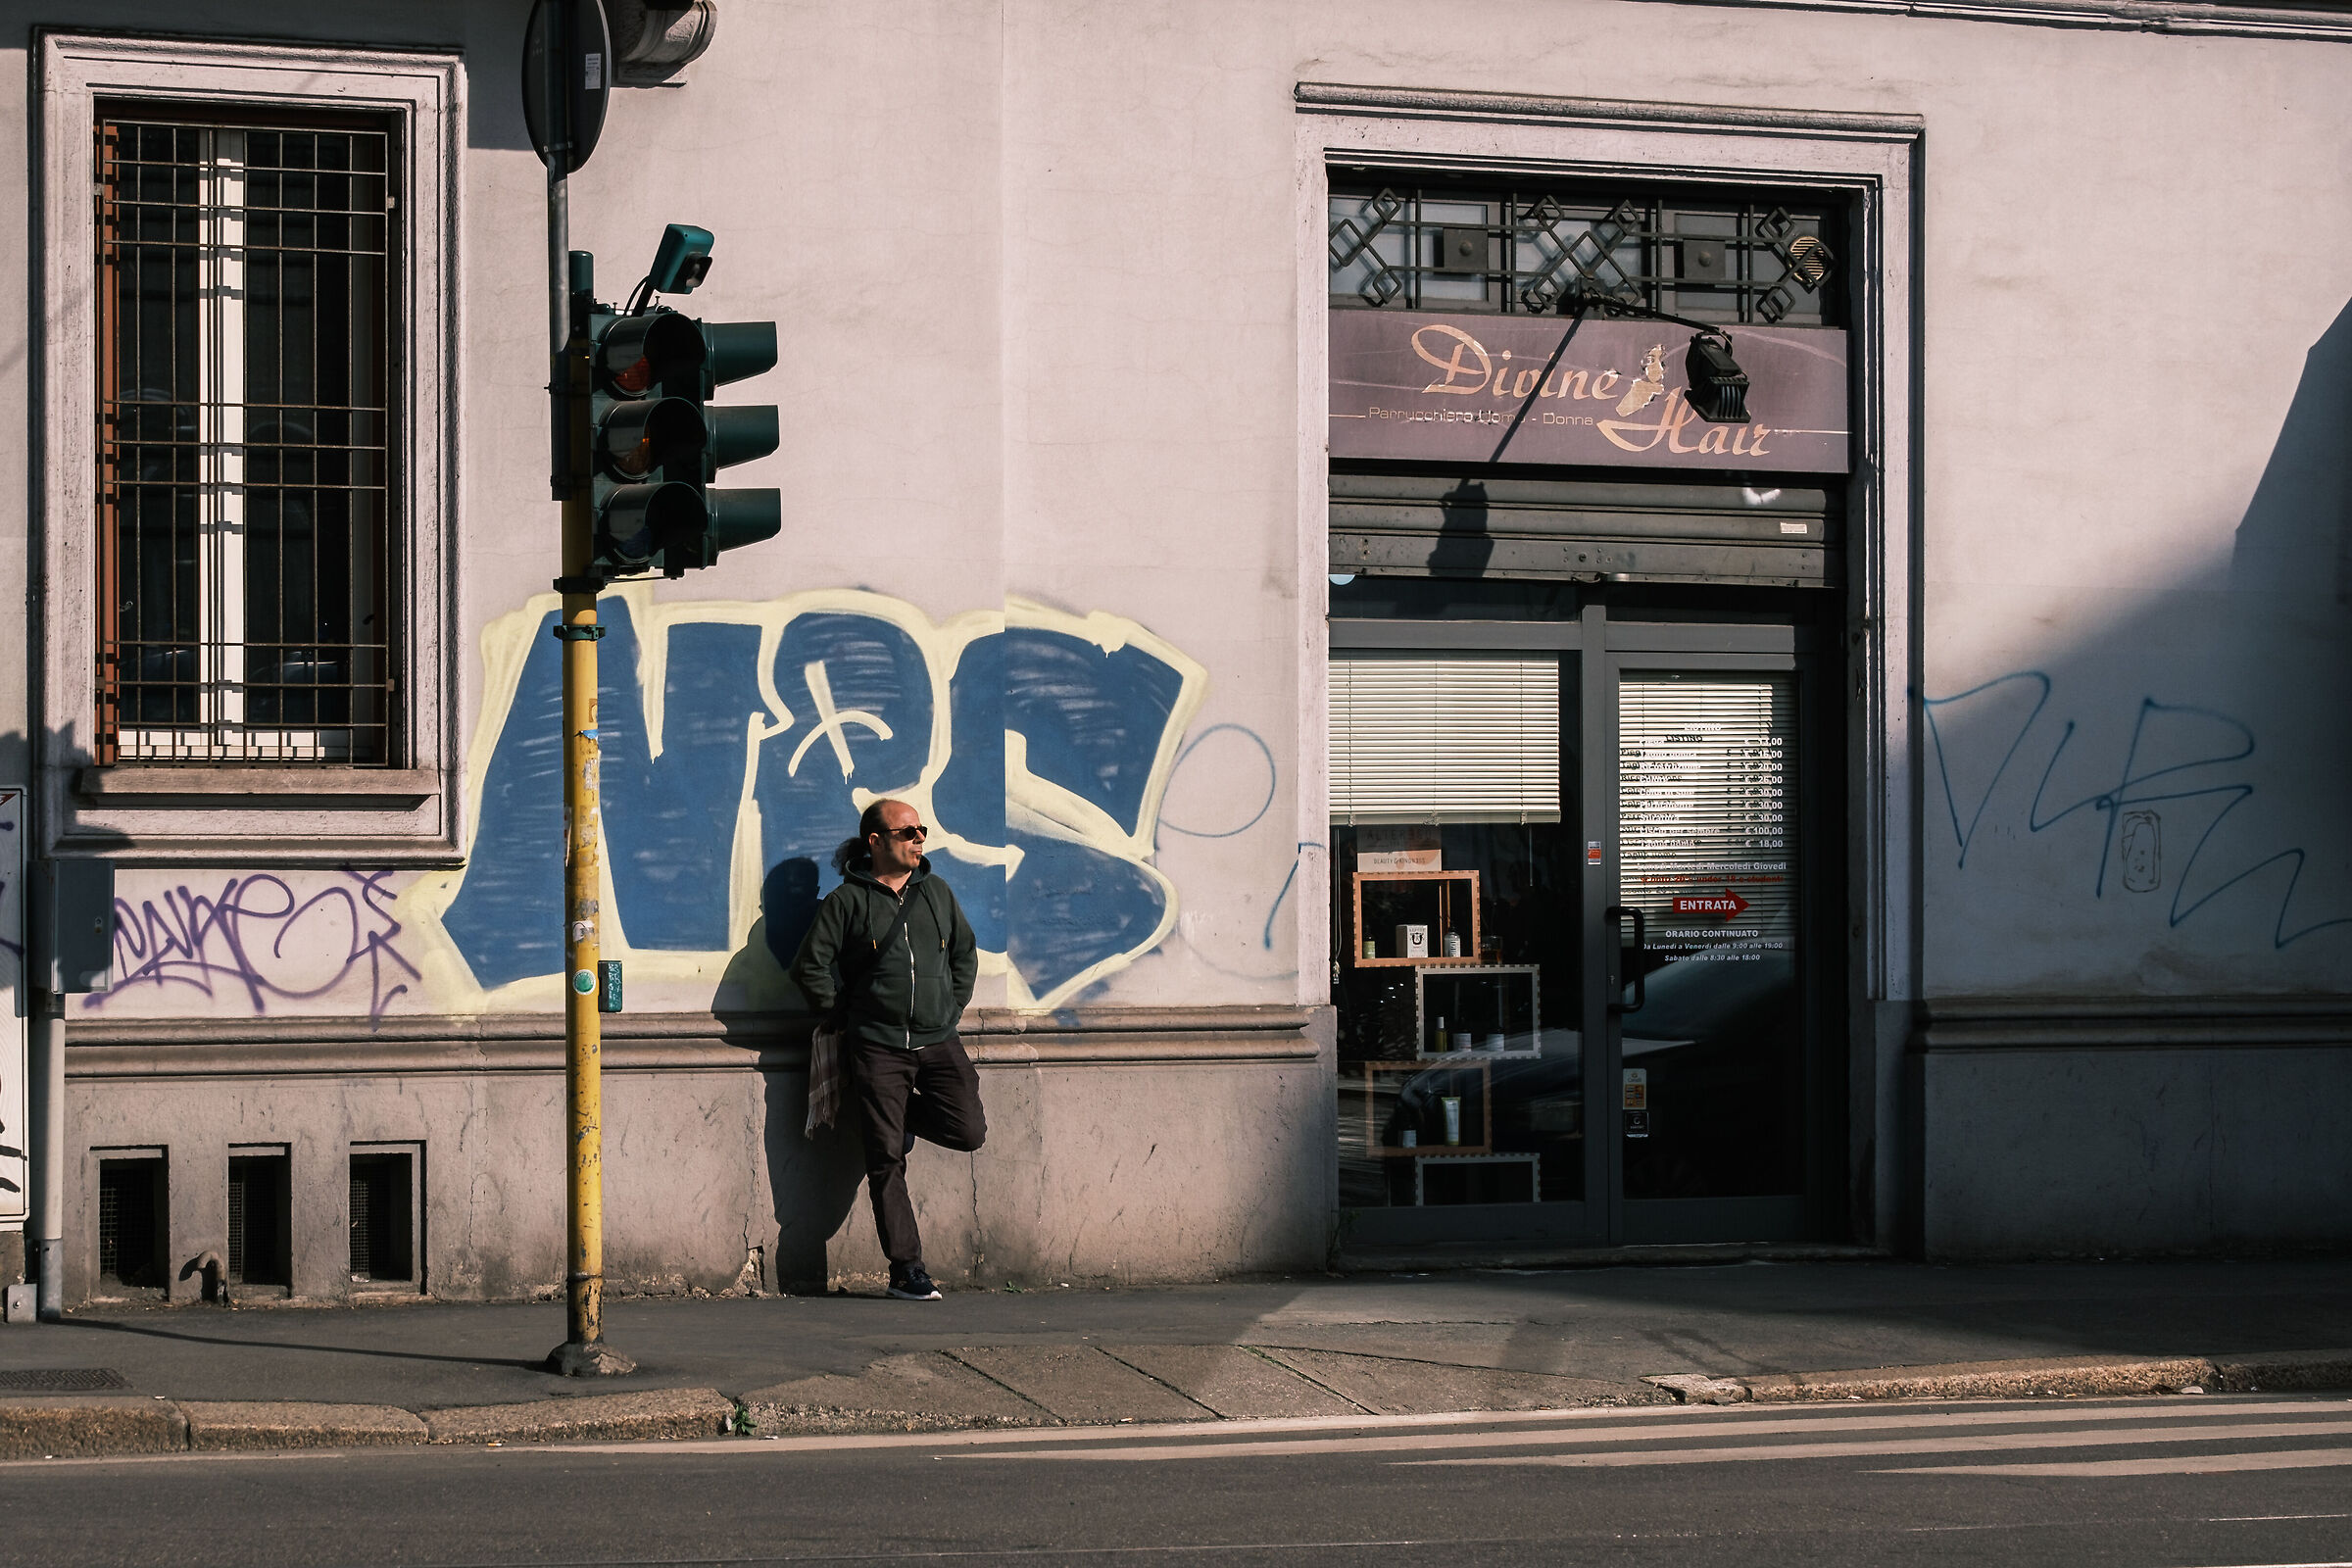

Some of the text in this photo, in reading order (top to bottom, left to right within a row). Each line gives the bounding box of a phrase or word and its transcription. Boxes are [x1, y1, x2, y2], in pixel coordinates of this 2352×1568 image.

[1411, 324, 1622, 400] Divine
[1543, 413, 1593, 425] Donna
[1596, 384, 1773, 457] Hair
[1758, 763, 1783, 772] 20,00
[1758, 789, 1783, 798] 30,00
[1758, 802, 1783, 810] 30,00
[1758, 814, 1783, 823] 30,00
[1753, 827, 1783, 836] 100,00
[1759, 840, 1783, 849] 18,00
[1680, 900, 1737, 910] ENTRATA
